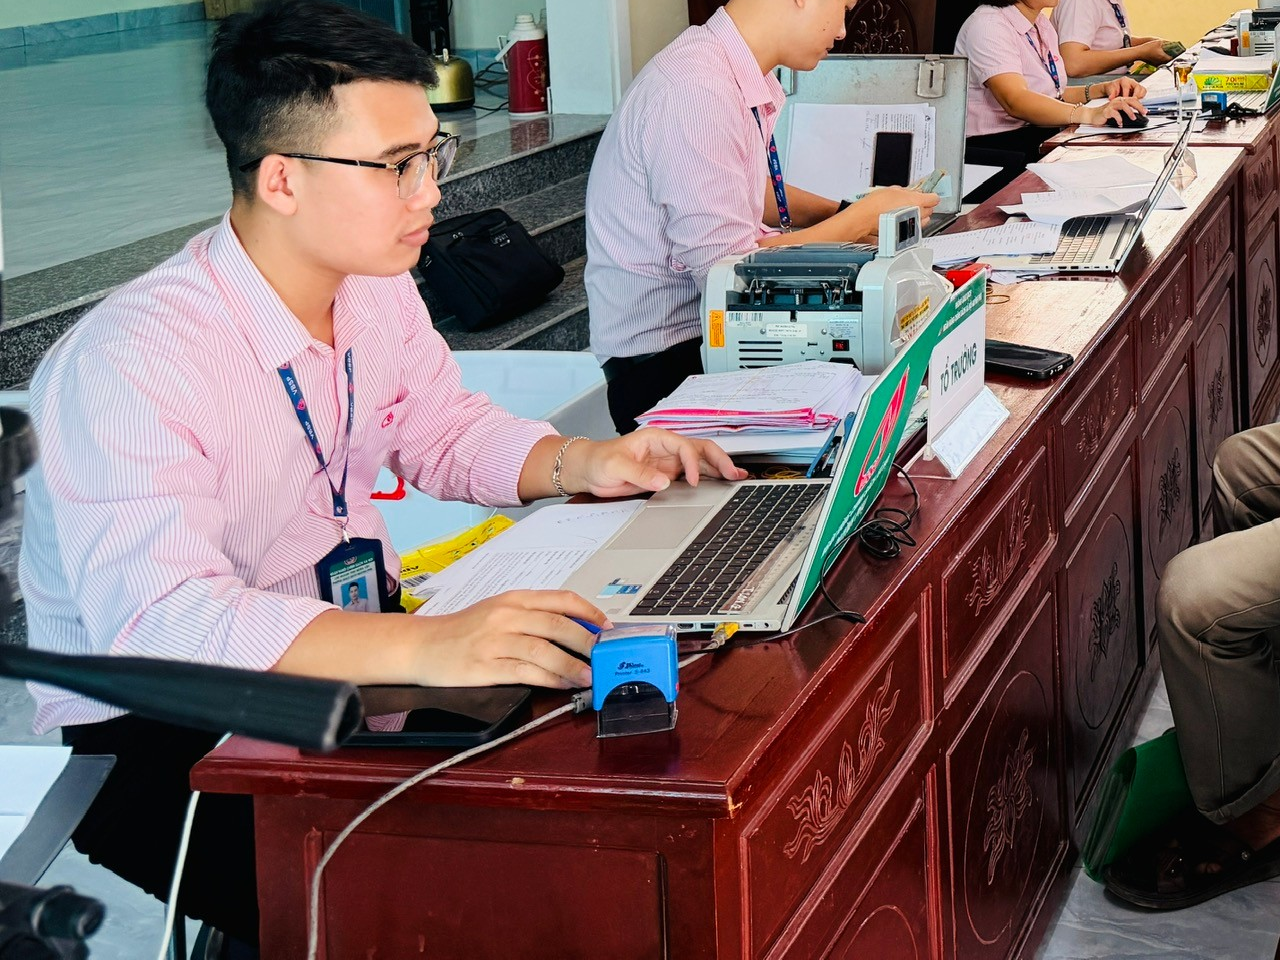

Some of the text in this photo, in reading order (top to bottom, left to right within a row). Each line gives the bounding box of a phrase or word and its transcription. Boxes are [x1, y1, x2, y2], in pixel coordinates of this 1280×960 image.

[940, 342, 978, 396] TỔ TRƯỞNG
[286, 376, 298, 395] VBSP
[305, 421, 314, 440] VBSP
